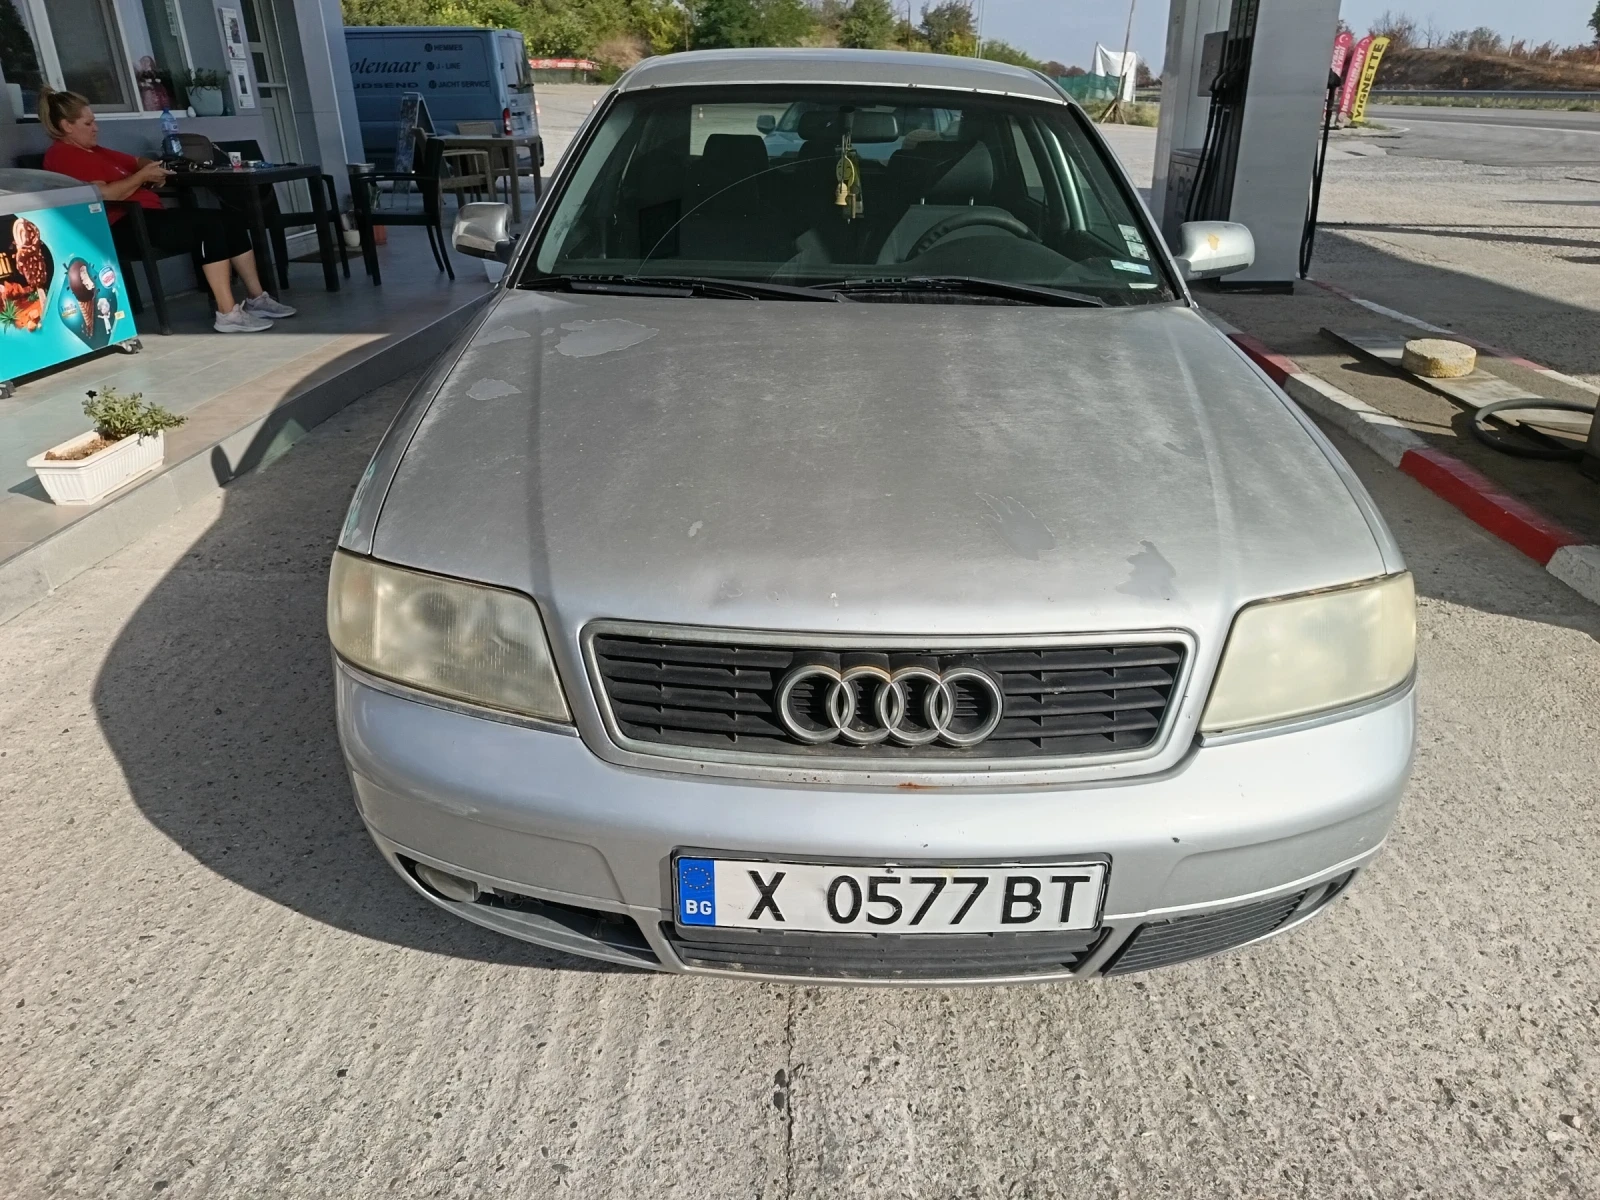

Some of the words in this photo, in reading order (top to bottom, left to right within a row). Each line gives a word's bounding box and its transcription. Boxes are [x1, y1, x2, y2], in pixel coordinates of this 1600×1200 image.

[350, 57, 421, 74] olenaar
[1354, 43, 1385, 118] VIGNETTE
[685, 900, 713, 917] BG
[747, 870, 787, 922] X
[826, 875, 990, 926] 0577
[1001, 873, 1092, 925] BT
